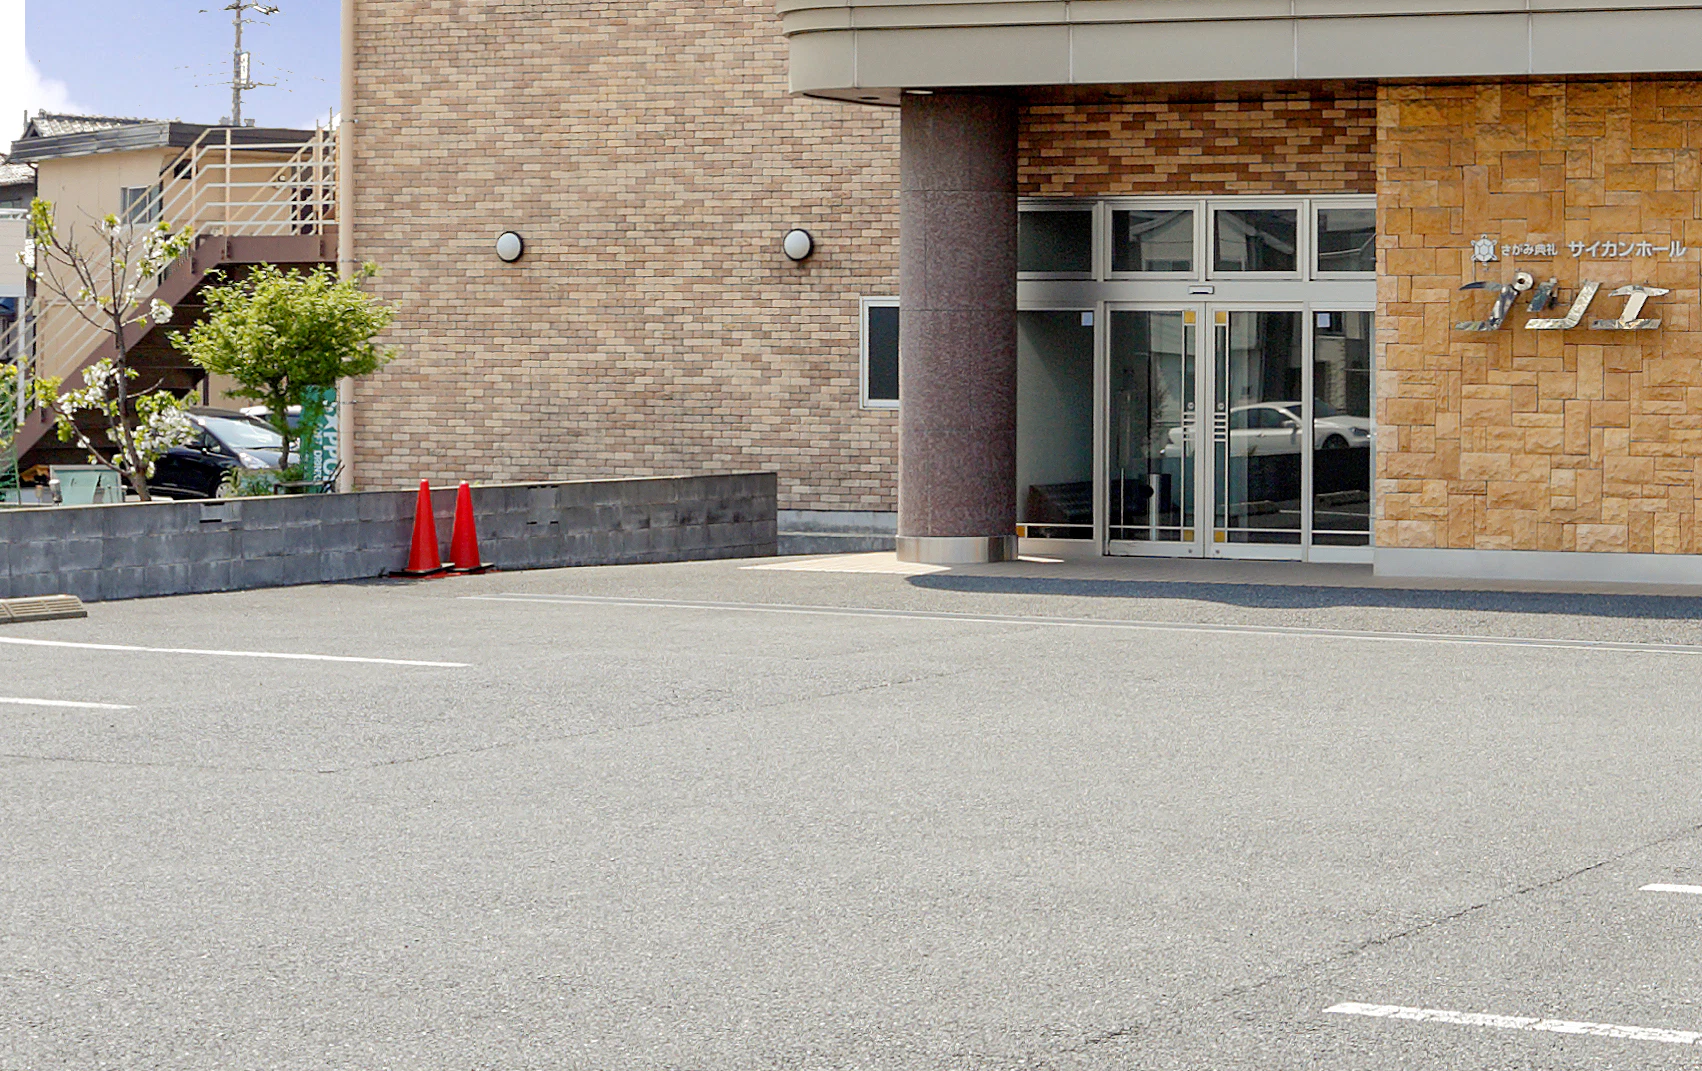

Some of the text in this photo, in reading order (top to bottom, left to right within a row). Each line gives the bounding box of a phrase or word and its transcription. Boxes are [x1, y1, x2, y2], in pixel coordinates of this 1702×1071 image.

[1501, 239, 1687, 258] さがみ典礼 サイカンホール
